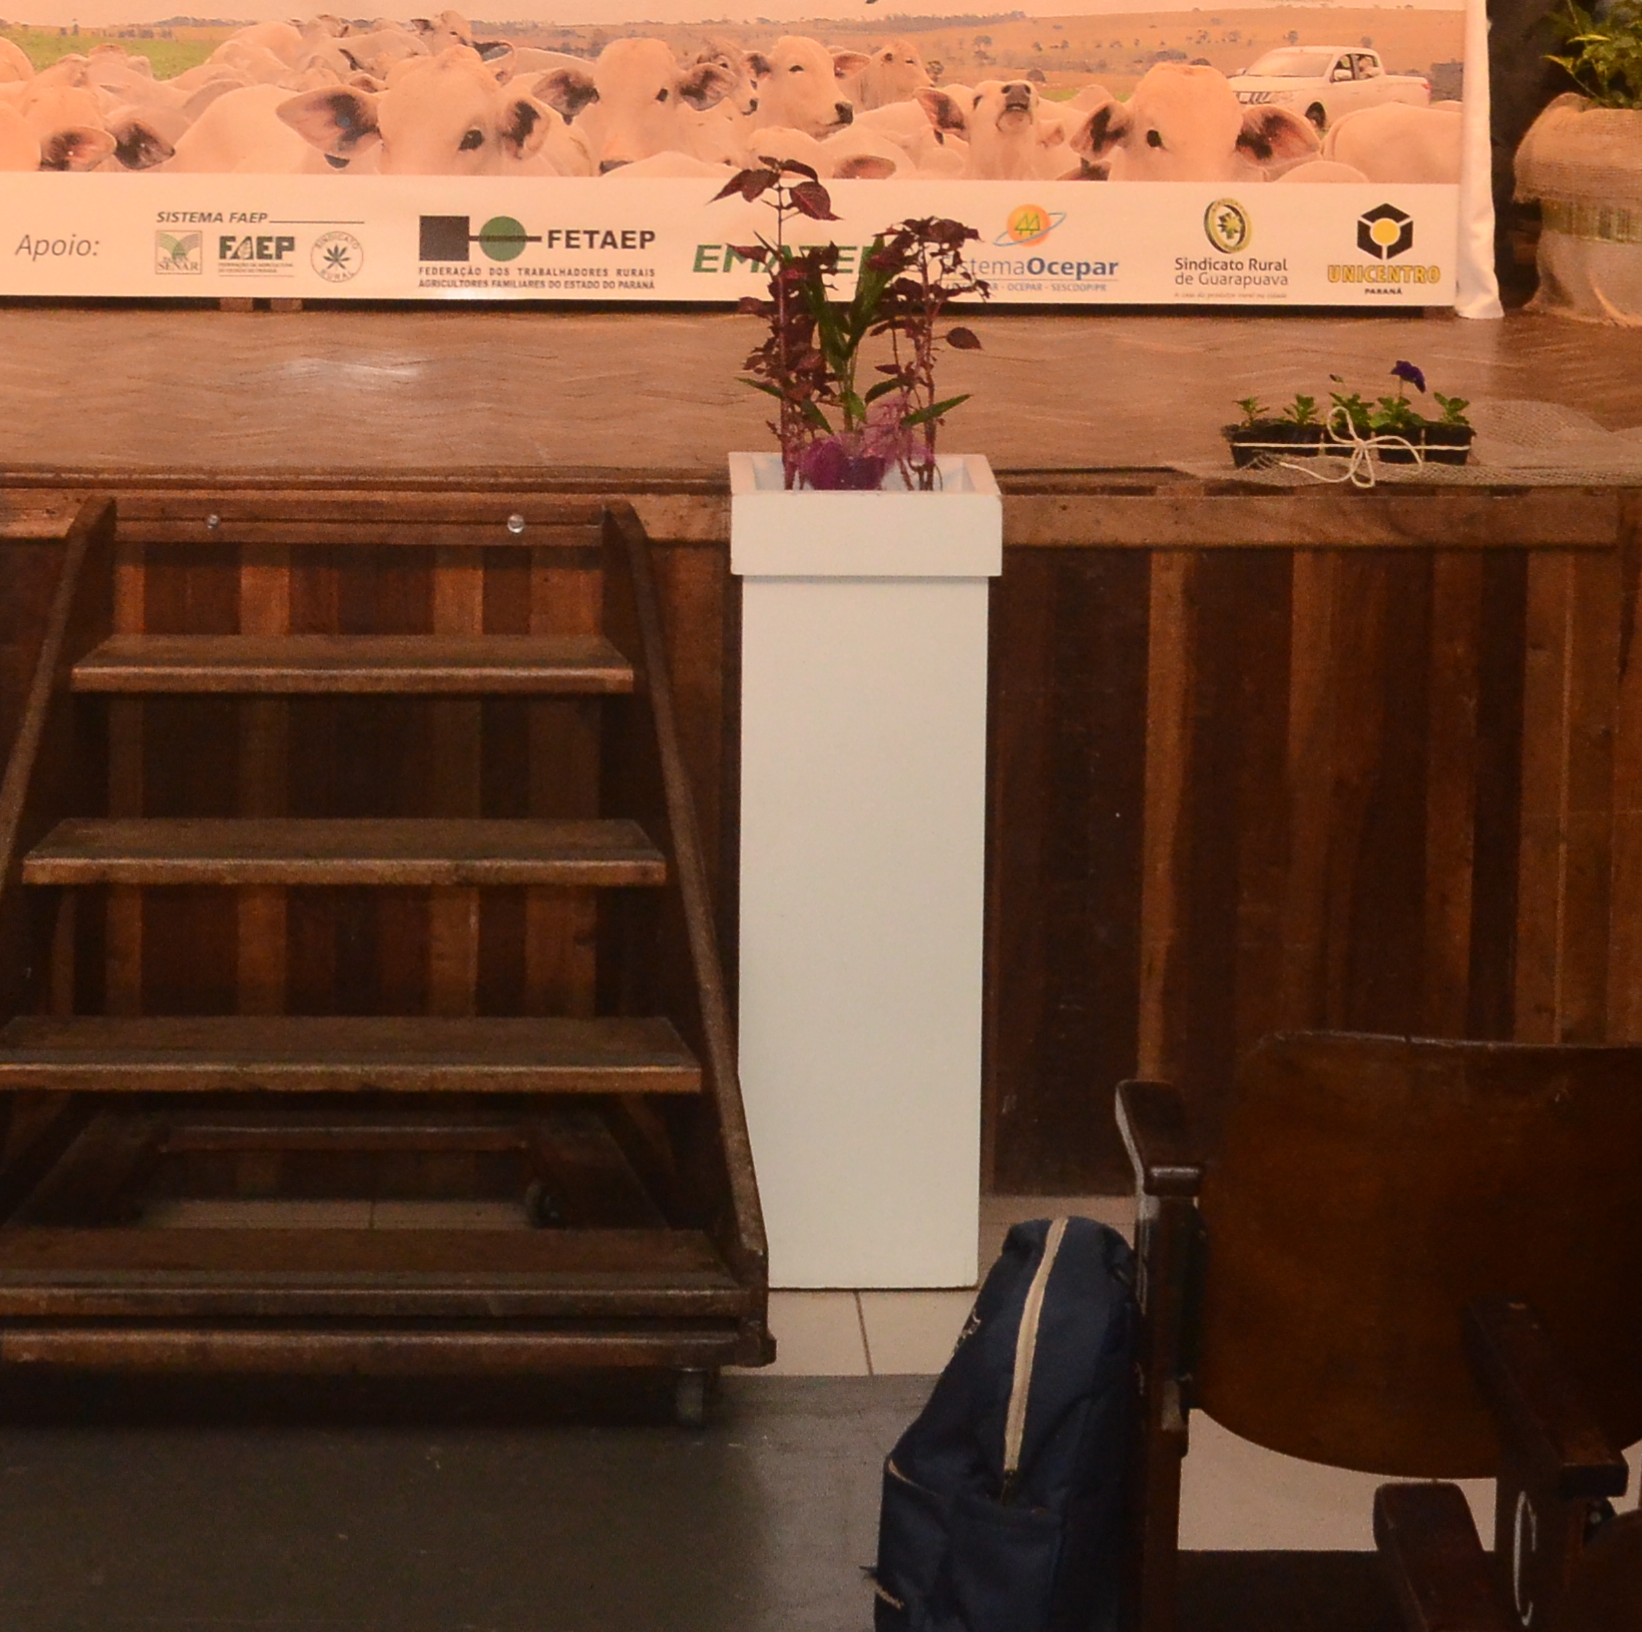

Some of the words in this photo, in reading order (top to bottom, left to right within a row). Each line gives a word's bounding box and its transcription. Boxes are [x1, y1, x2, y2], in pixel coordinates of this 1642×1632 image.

[156, 211, 224, 223] SISTEMA
[229, 212, 268, 223] FAEP
[547, 229, 656, 250] FETAEP
[14, 233, 99, 263] Apoio:
[219, 235, 296, 260] FAEP
[419, 265, 481, 278] FEDERAÇÃO
[489, 267, 510, 277] DOS
[517, 267, 609, 277] TRABALHADORES
[616, 267, 656, 277] RURAIS
[944, 255, 1119, 280] stemaOcepar
[1175, 257, 1244, 271] Sindicato
[1248, 257, 1288, 272] Rural
[1174, 272, 1194, 285] de
[1198, 272, 1289, 288] Guarapuava
[1327, 265, 1441, 284] UNICENTRO
[418, 279, 489, 288] AGRICULTORES
[548, 280, 561, 289] DO
[564, 280, 600, 289] ESTADO
[602, 280, 616, 289] DO
[1007, 282, 1043, 291] OCEPAR
[1364, 287, 1403, 295] PARANÁ
